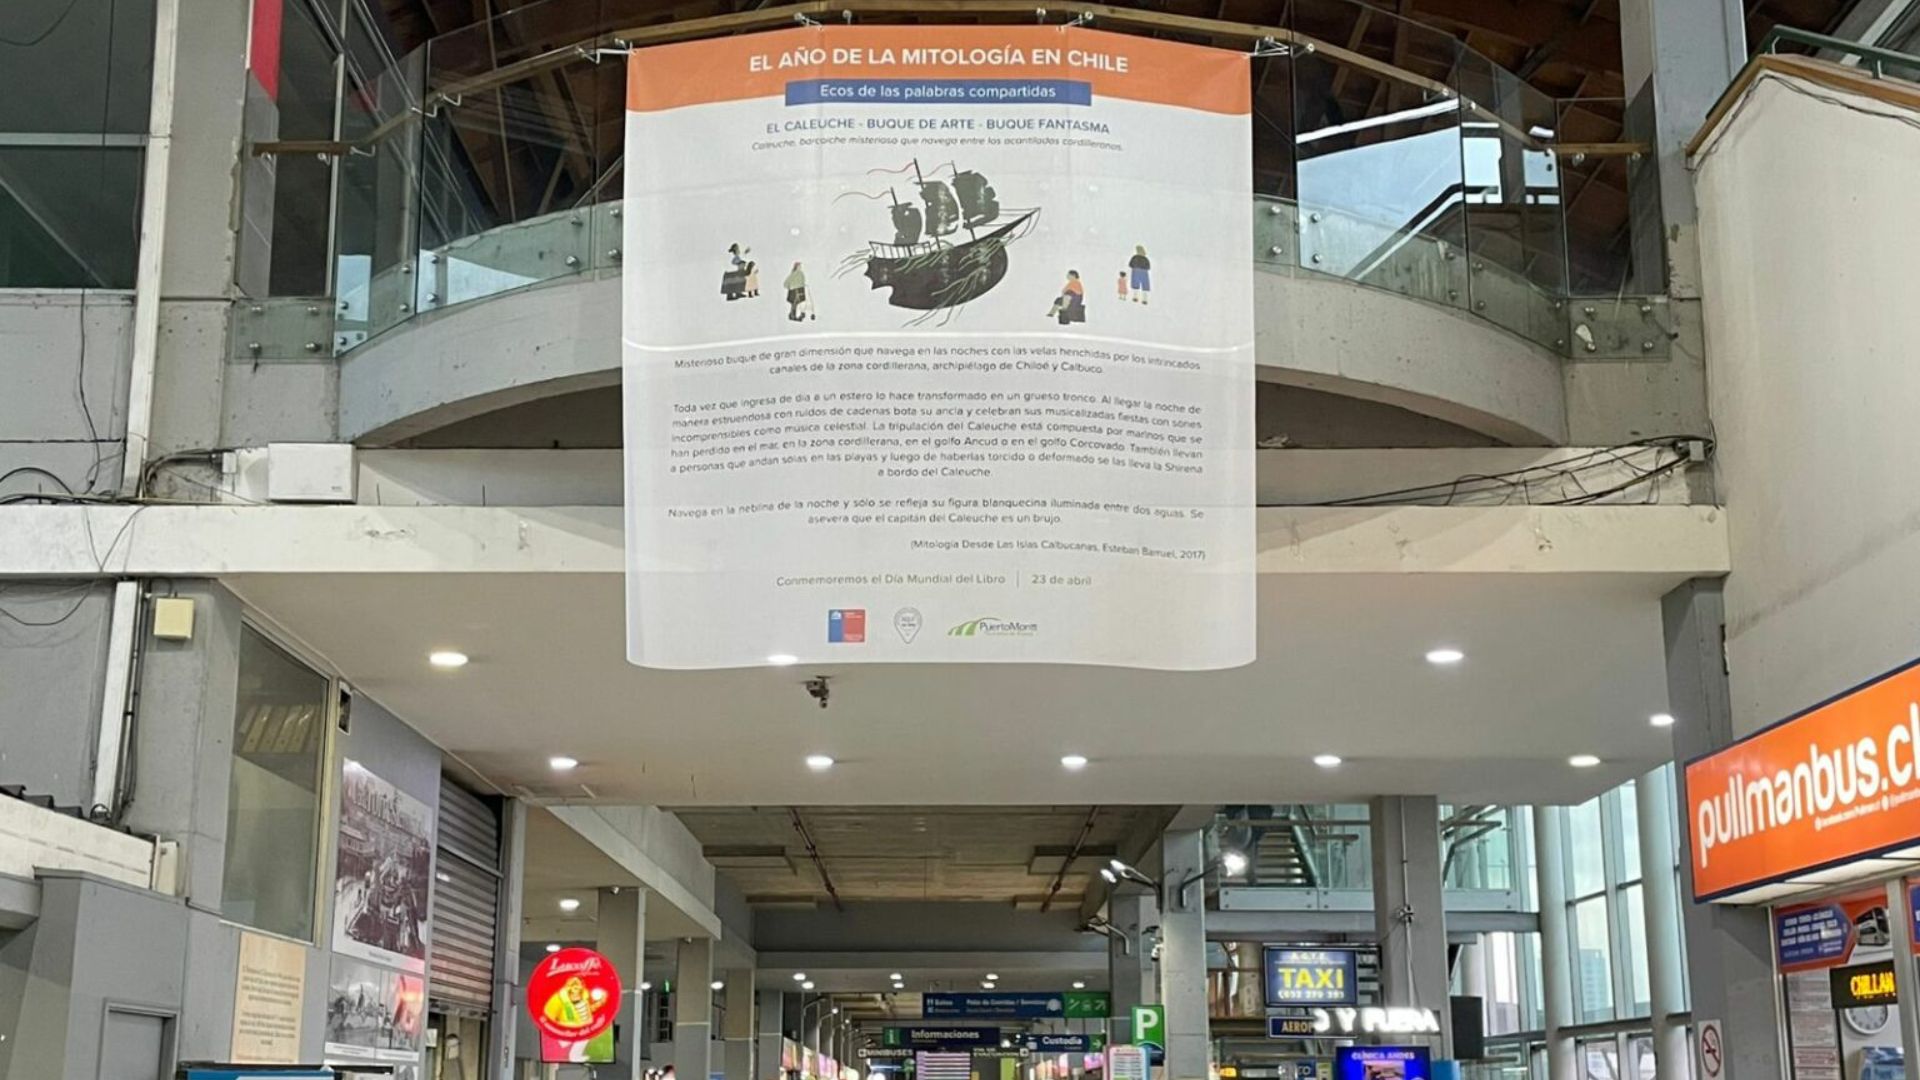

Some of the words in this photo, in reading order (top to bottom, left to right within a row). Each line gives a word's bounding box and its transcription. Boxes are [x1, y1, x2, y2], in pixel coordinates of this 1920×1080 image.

[749, 54, 772, 72] EL
[778, 46, 828, 66] AÑO
[832, 48, 864, 64] DE
[867, 48, 897, 64] LA
[901, 44, 1027, 64] MITOLOGÍA
[1031, 48, 1063, 64] EN
[1067, 49, 1130, 73] CHILE
[819, 84, 853, 96] Ecos
[857, 85, 876, 95] de
[879, 85, 900, 96] las
[903, 86, 964, 99] palabras
[968, 86, 1056, 99] compartidas
[765, 122, 780, 134] EL
[783, 118, 854, 131] CALEUCHE
[866, 118, 914, 128] BUQUE
[918, 119, 936, 128] DE
[940, 119, 974, 129] ARTE
[985, 118, 1033, 129] BUQUE
[1037, 118, 1110, 133] FANTASMA
[673, 357, 724, 367] Misterioso
[725, 353, 756, 365] buque
[773, 350, 796, 360] gran
[852, 347, 874, 355] que
[875, 347, 915, 356] navega
[932, 346, 948, 355] las
[949, 347, 988, 355] noches
[990, 347, 1010, 355] con
[1029, 346, 1057, 356] velas
[1058, 347, 1111, 359] henchidas
[1112, 353, 1129, 362] por
[1130, 353, 1146, 363] los
[768, 363, 808, 374] canales
[837, 362, 863, 370] zona
[1014, 360, 1049, 370] Chiloé
[673, 402, 697, 413] Toda
[699, 402, 716, 410] vez
[718, 400, 738, 410] que
[740, 396, 776, 409] ingresa
[838, 392, 873, 400] estero
[888, 392, 914, 400] hace
[916, 391, 987, 400] transformado
[1022, 392, 1060, 402] grueso
[1113, 396, 1141, 410] llegar
[1154, 402, 1186, 412] noche
[671, 418, 709, 427] manera
[710, 411, 771, 424] estruendosa
[773, 410, 792, 419] con
[794, 408, 826, 417] ruidos
[845, 407, 890, 415] cadenas
[892, 407, 917, 415] bota
[974, 407, 1021, 415] celebran
[1044, 407, 1115, 419] musicalizadas
[1150, 417, 1170, 426] con
[1171, 419, 1202, 428] sones
[753, 426, 781, 436] como
[946, 422, 964, 430] del
[966, 421, 1017, 430] Caleuche
[1046, 423, 1103, 433] compuesta
[1105, 427, 1123, 436] por
[1125, 429, 1164, 440] marinos
[1166, 434, 1186, 444] que
[670, 448, 690, 457] han
[691, 445, 730, 458] perdido
[809, 438, 835, 447] zona
[933, 437, 961, 447] golfo
[963, 437, 998, 445] Ancud
[1039, 437, 1067, 448] golfo
[678, 462, 724, 473] personas
[726, 459, 746, 470] que
[748, 456, 779, 467] andan
[781, 455, 807, 463] solas
[826, 453, 841, 461] las
[843, 453, 878, 462] playas
[889, 453, 920, 463] luego
[939, 452, 985, 461] haberlas
[987, 452, 1025, 461] torcido
[1037, 452, 1095, 463] deformado
[1111, 457, 1126, 466] las
[886, 468, 919, 476] bordo
[920, 468, 938, 476] del
[667, 508, 708, 518] Navega
[806, 499, 840, 508] noche
[981, 498, 1047, 508] blanquecina
[1050, 498, 1100, 510] iluminada
[1102, 502, 1129, 512] entre
[1132, 504, 1150, 515] dos
[807, 515, 849, 523] asevera
[850, 515, 872, 523] que
[928, 514, 946, 522] del
[947, 513, 998, 522] Caleuche
[960, 539, 994, 548] Desde
[996, 540, 1014, 548] Las
[1015, 540, 1038, 548] Islas
[775, 575, 868, 586] Conmemoremos
[884, 573, 904, 583] Día
[906, 574, 952, 583] Mundial
[954, 574, 974, 583] del
[975, 574, 1006, 583] Libro
[1031, 574, 1046, 584] 23
[1066, 576, 1092, 585] abril
[979, 622, 1038, 632] PuertoMontt
[1278, 968, 1344, 989] TAXI
[1135, 1008, 1158, 1040] P
[1335, 1007, 1357, 1032] Y
[911, 1029, 980, 1039] Informaciones
[1042, 1036, 1083, 1045] Custodia
